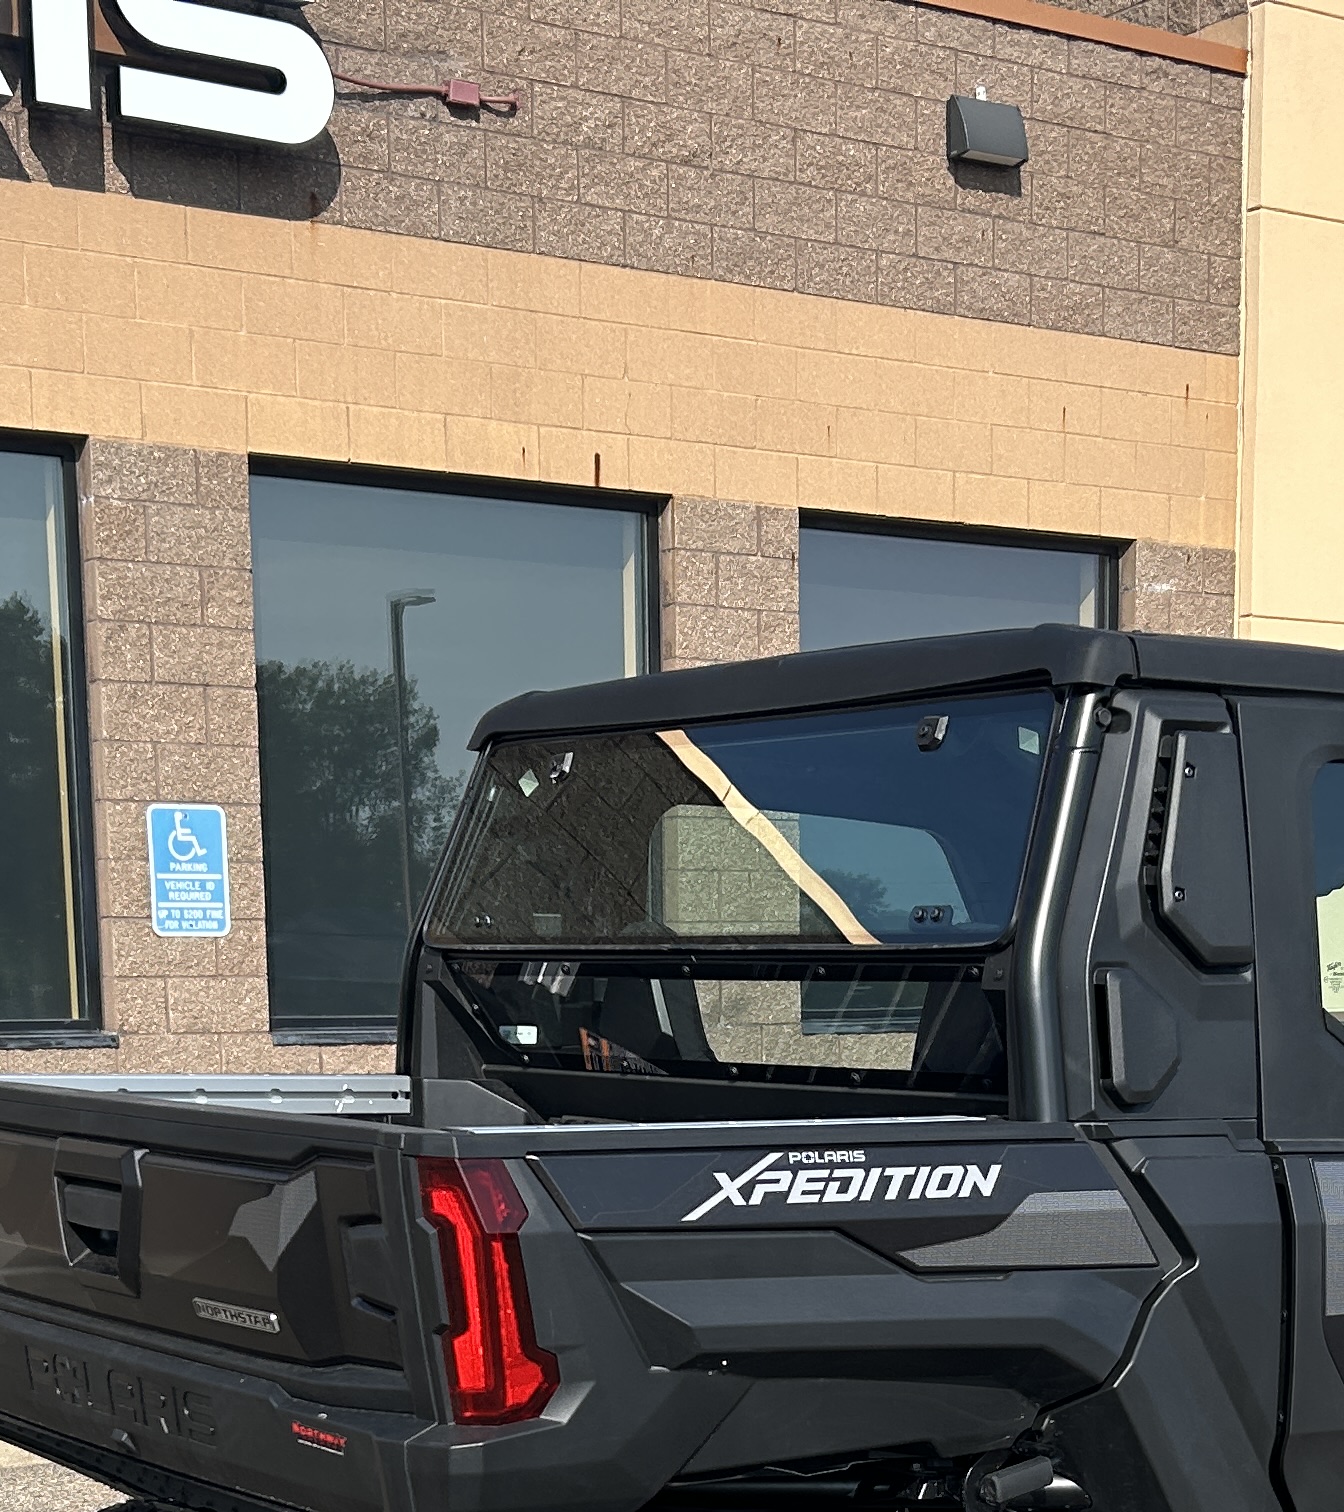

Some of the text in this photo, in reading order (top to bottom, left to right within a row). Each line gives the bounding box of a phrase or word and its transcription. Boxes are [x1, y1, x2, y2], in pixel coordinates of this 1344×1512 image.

[169, 862, 208, 872] PARKING
[164, 880, 201, 890] VEHICLE
[168, 891, 212, 901] REQUIRED
[171, 910, 181, 919] TO
[788, 1150, 866, 1164] POLARIS
[680, 1152, 1003, 1221] XPEDITION
